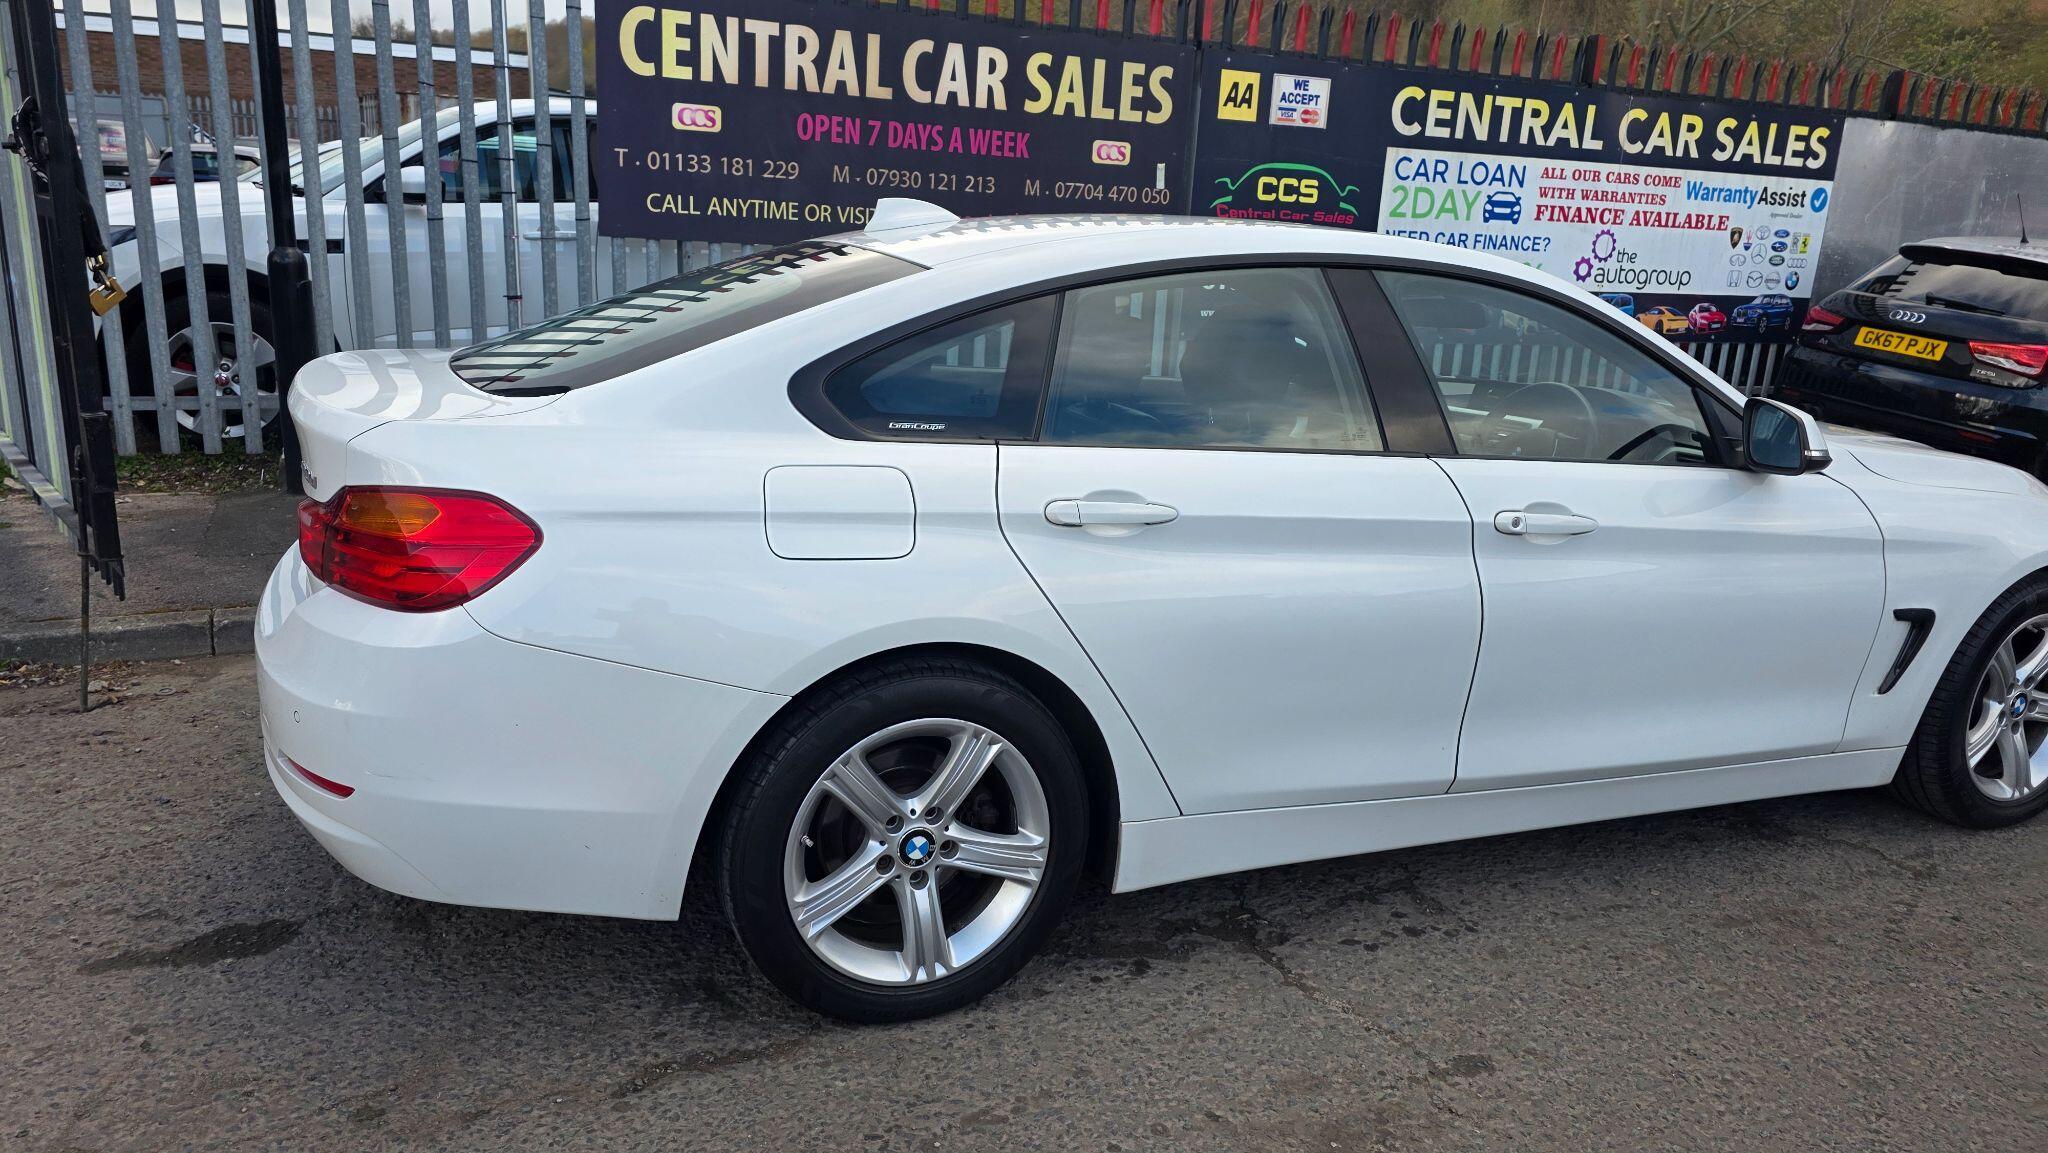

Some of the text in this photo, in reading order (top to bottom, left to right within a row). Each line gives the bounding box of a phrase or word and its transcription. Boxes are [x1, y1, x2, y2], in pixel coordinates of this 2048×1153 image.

[619, 5, 1174, 124] CENTRAL CAR SALES
[1223, 82, 1254, 109] AA
[1294, 79, 1309, 91] WE
[1280, 92, 1320, 106] ACCEPT
[797, 113, 1030, 158] OPEN 7 DAYS A WEEK
[1391, 86, 1831, 170] CENTRAL CAR SALES
[647, 151, 713, 174] 01133
[720, 157, 753, 177] 181
[762, 160, 800, 180] 229
[1394, 156, 1527, 188] CAR LOAN
[1540, 167, 1682, 188] ALL OUR CARS COME
[866, 168, 921, 188] 07930
[928, 173, 956, 191] 121
[964, 175, 996, 193] 213
[1055, 182, 1103, 200] 07704
[1108, 186, 1137, 203] 470
[1142, 187, 1170, 205] 050
[1257, 176, 1319, 204] CCS
[646, 193, 701, 215] CALL
[707, 197, 799, 221] ANYTIME
[804, 203, 831, 222] OR
[1389, 185, 1482, 221] 2DAY
[1539, 187, 1667, 206] WITH WARRANTIES
[1216, 204, 1354, 225] Central Car Sales
[1534, 205, 1730, 231] FINANCE AVAILABLE
[1473, 234, 1551, 252] FINANCE?
[1616, 248, 1637, 264] the
[1594, 266, 1692, 290] autogroup
[1863, 331, 1940, 357] GK67 PJX
